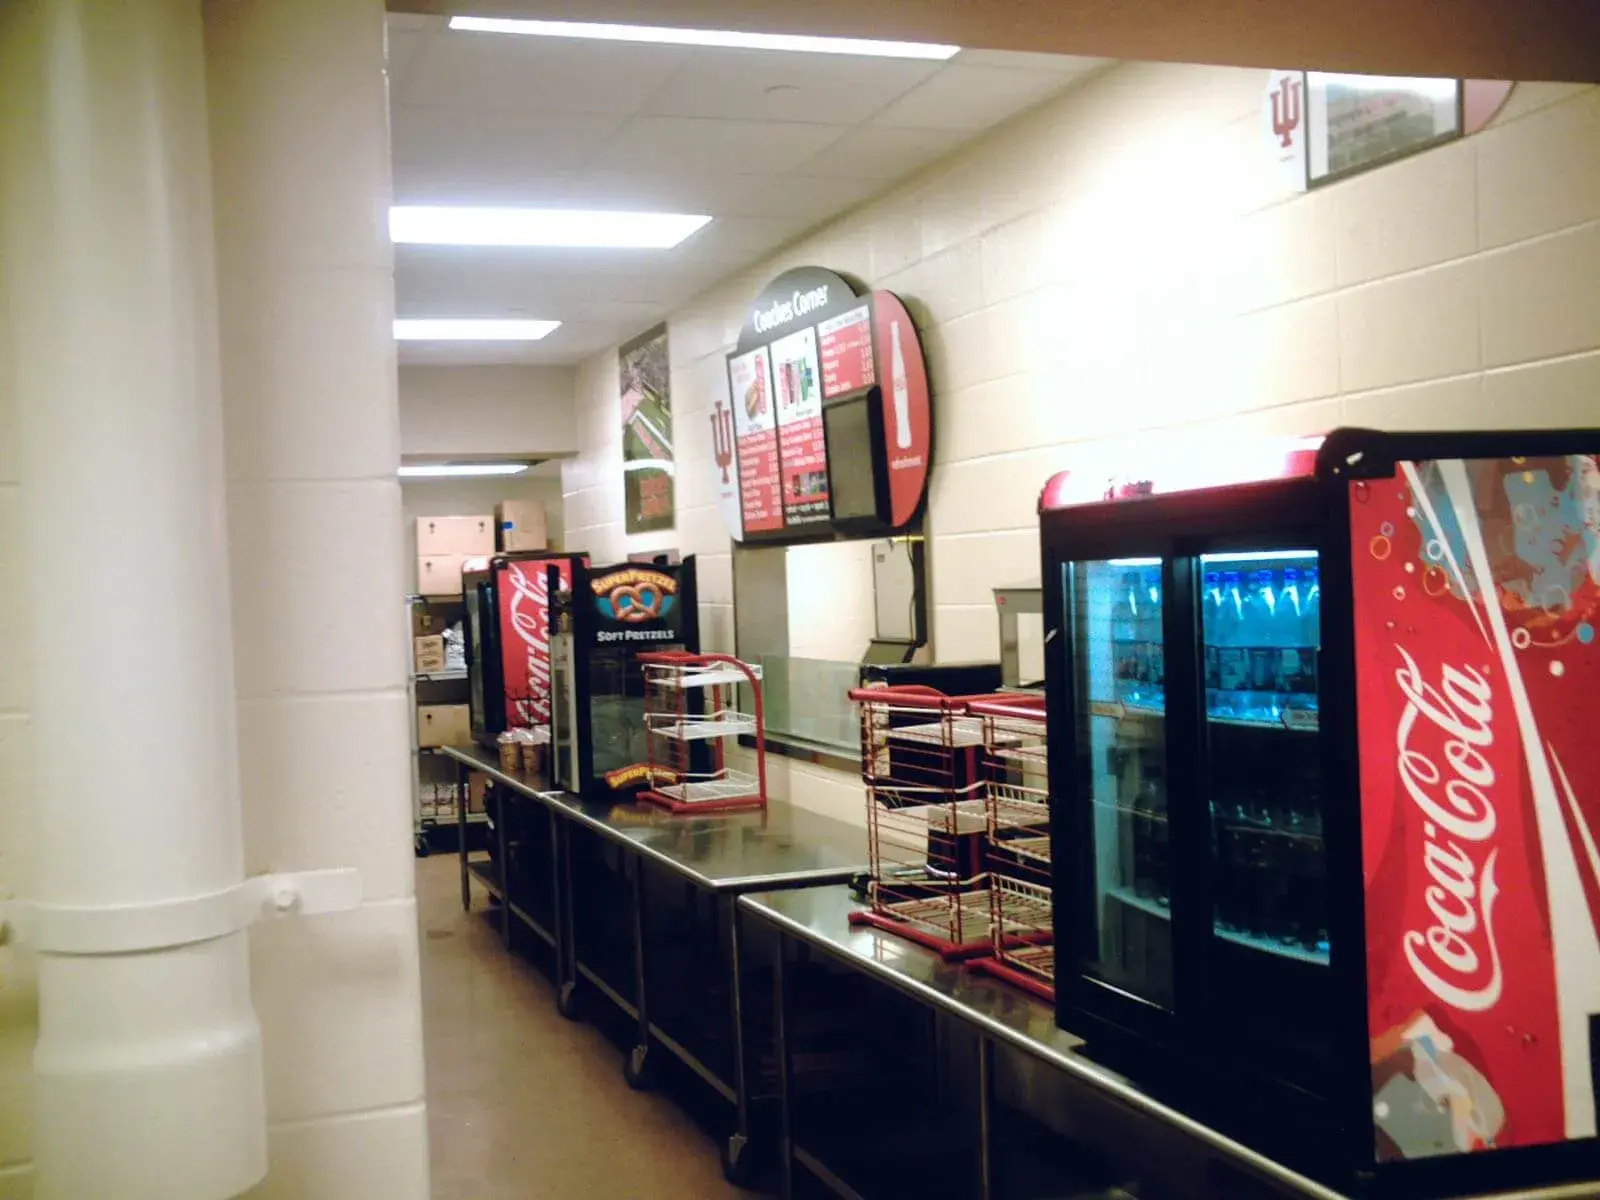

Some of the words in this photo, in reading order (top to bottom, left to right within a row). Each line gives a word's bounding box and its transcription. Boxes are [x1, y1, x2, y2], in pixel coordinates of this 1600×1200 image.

[793, 284, 829, 316] Corner
[597, 630, 624, 641] SOFT
[625, 629, 675, 640] PRETZELS
